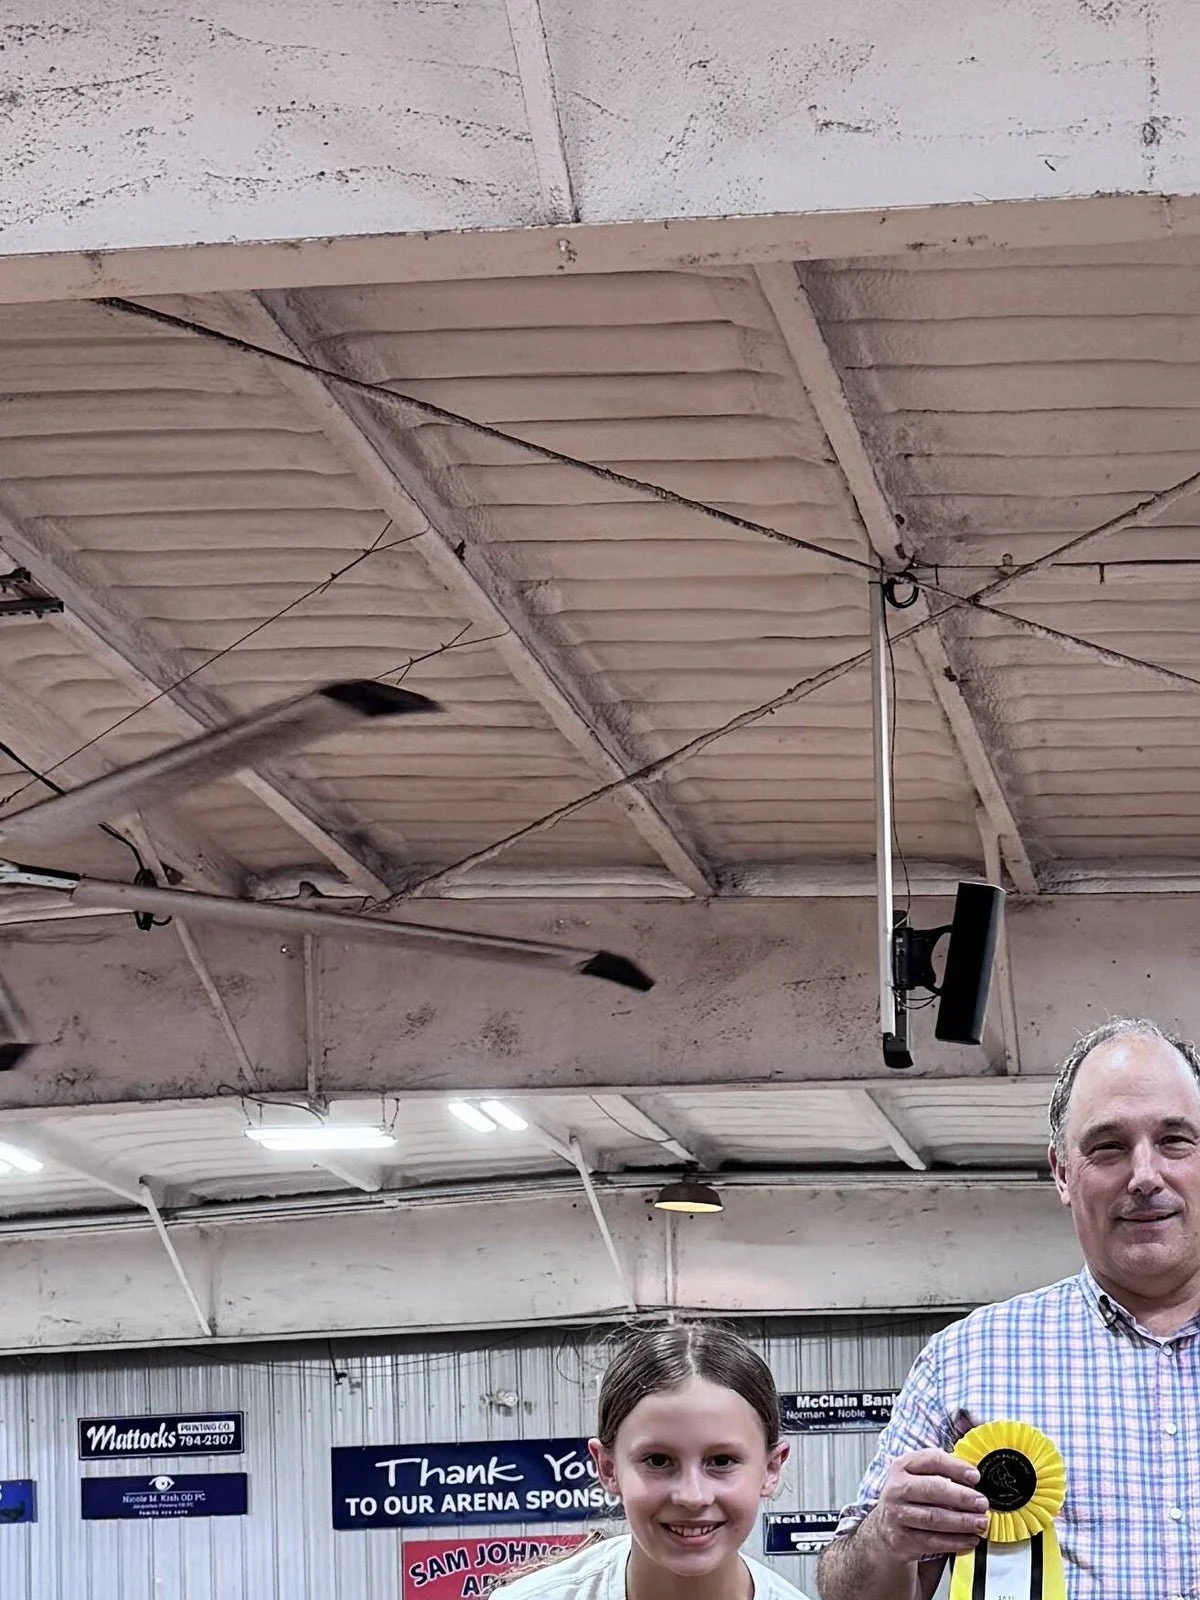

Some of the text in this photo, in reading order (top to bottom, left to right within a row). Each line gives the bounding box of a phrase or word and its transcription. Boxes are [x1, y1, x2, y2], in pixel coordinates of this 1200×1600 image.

[796, 1394, 858, 1408] McClain
[786, 1410, 825, 1419] Norman
[837, 1409, 866, 1418] Noble
[86, 1422, 177, 1451] Mattocks
[180, 1422, 216, 1432] PRINTING
[180, 1434, 235, 1447] 794-2307
[375, 1450, 599, 1488] Thank You
[345, 1497, 377, 1516] TO
[384, 1495, 434, 1514] OUR
[440, 1492, 520, 1513] ARENA
[408, 1547, 470, 1588] SAM
